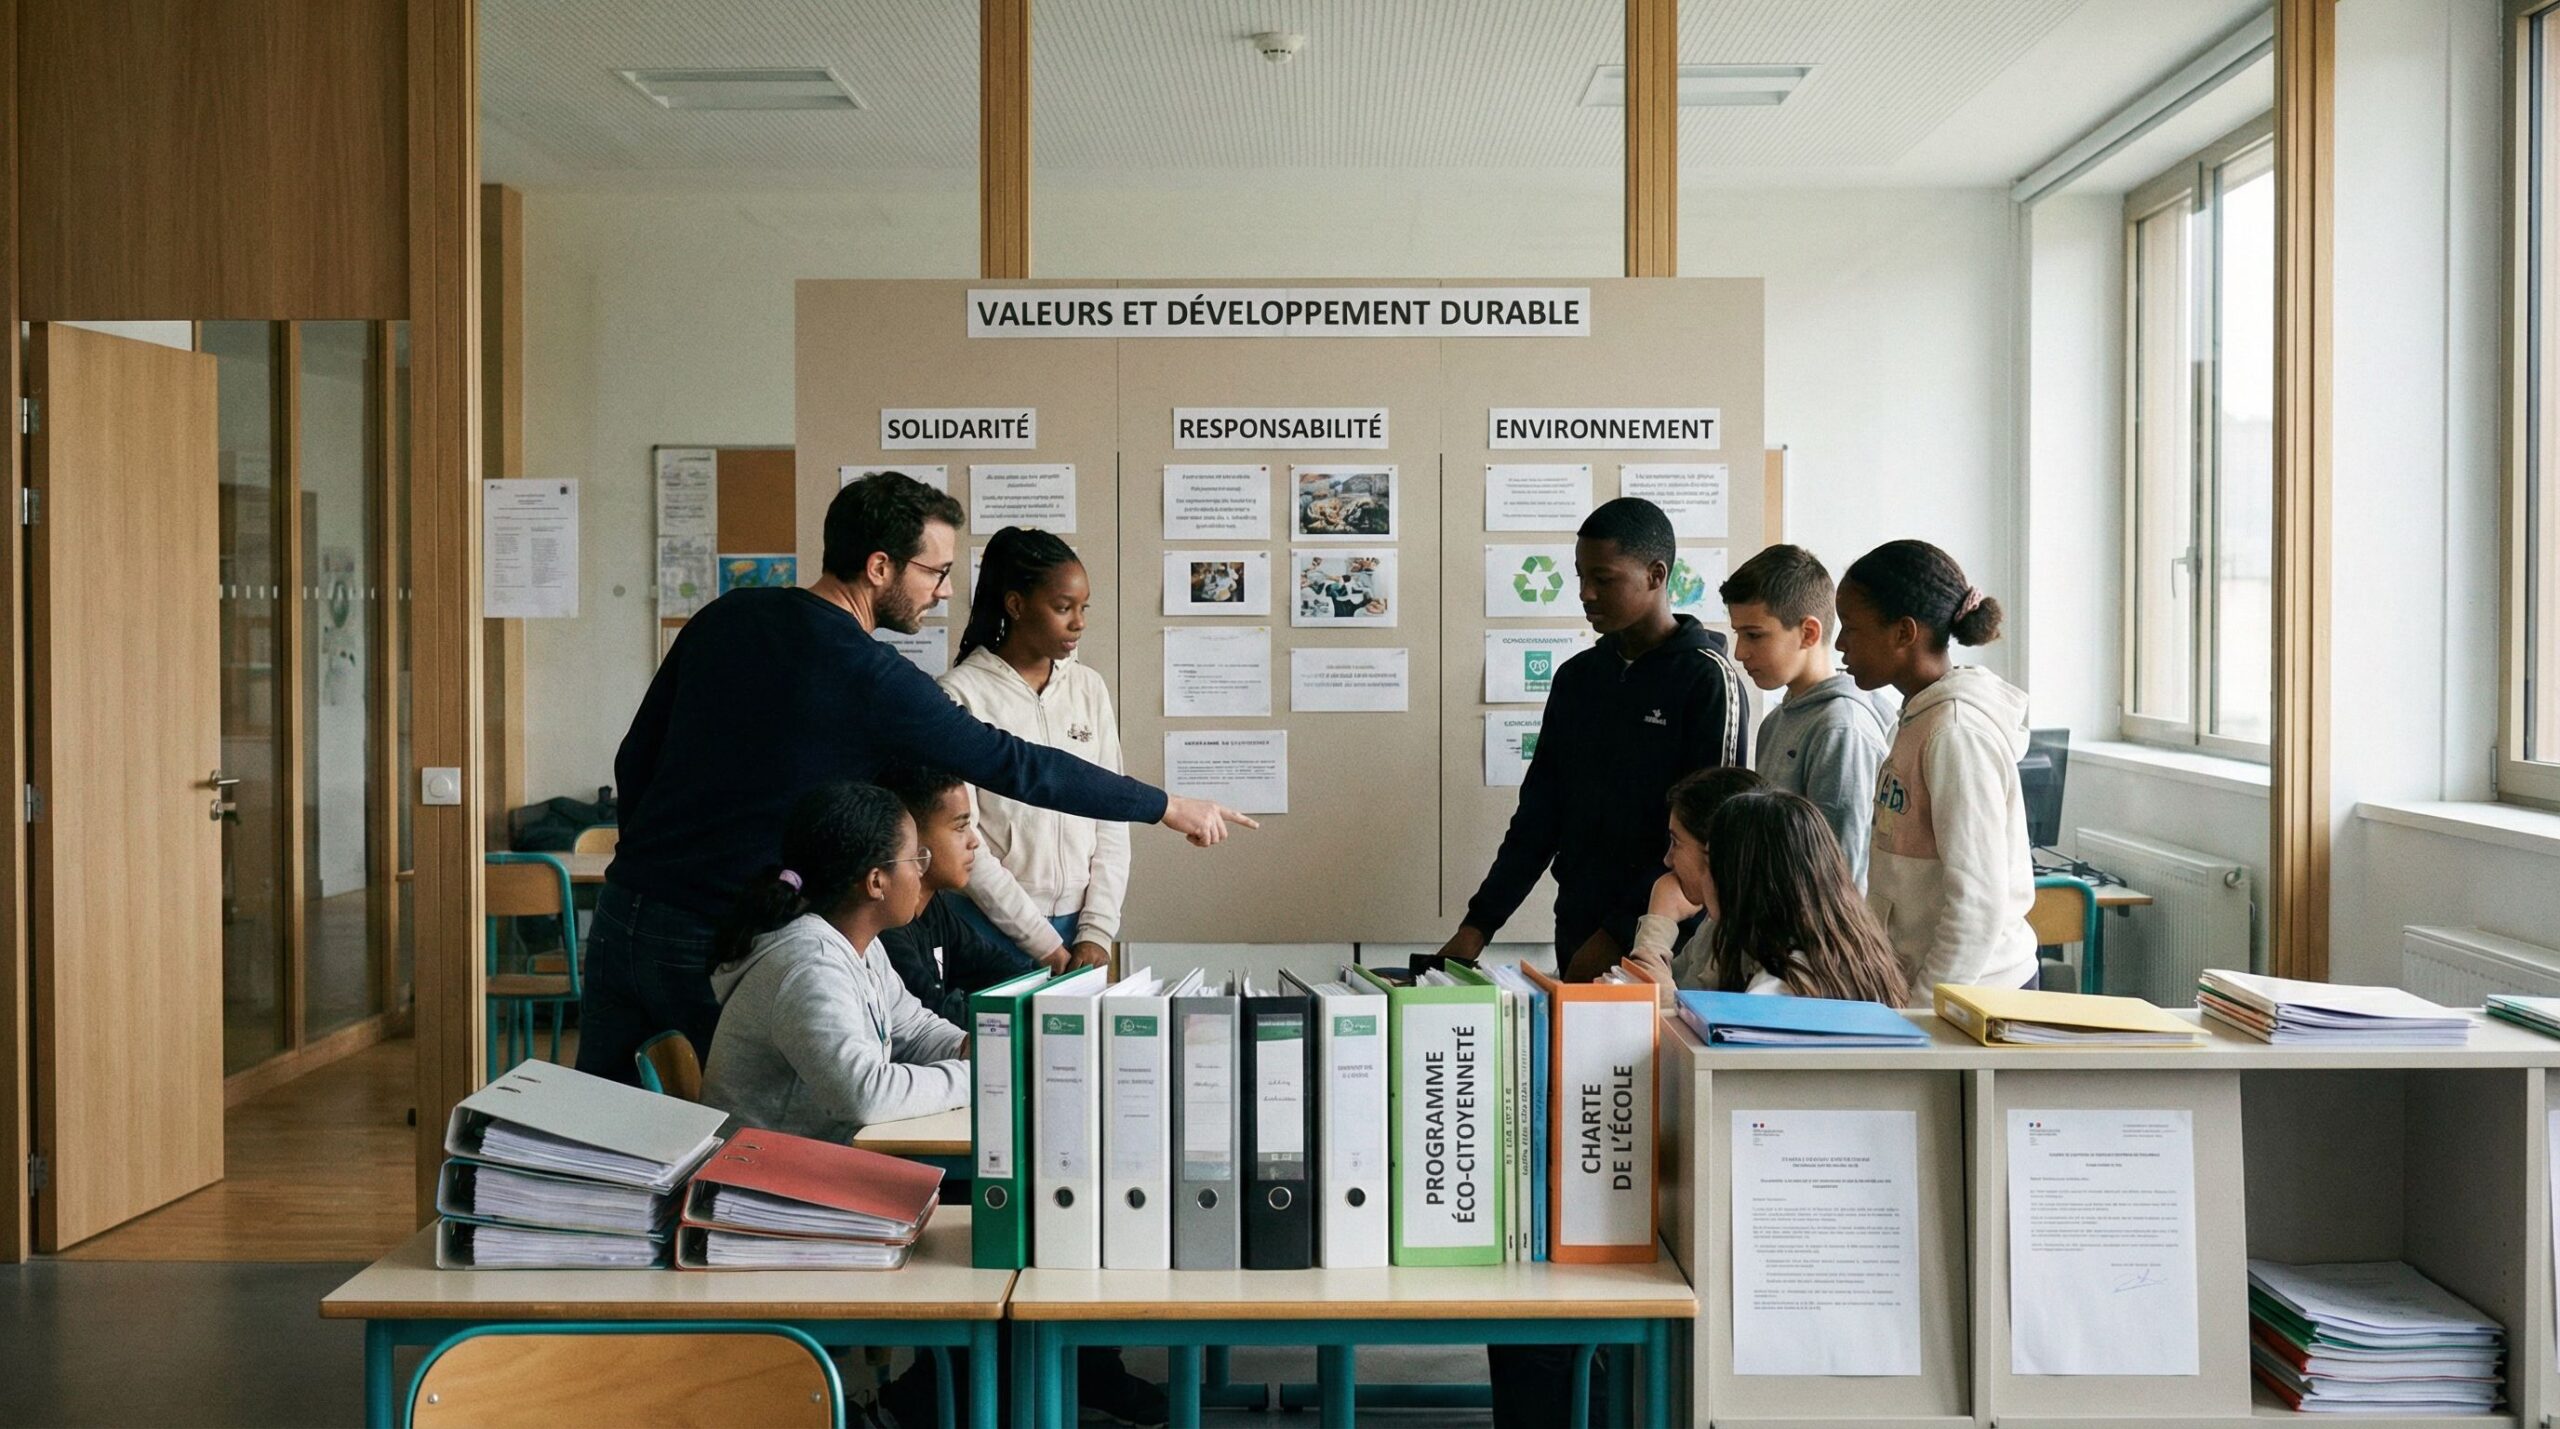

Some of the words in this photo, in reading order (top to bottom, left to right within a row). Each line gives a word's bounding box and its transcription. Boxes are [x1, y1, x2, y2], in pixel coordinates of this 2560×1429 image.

[977, 300, 1113, 327] VALEURS
[1123, 301, 1158, 326] ET
[1167, 293, 1431, 326] DÉVELOPPEMENT
[1441, 300, 1579, 325] DURABLE
[887, 413, 1029, 440] SOLIDARITÉ
[1180, 413, 1382, 440] RESPONSABILITÉ
[1496, 419, 1714, 440] ENVIRONNEMENT
[1451, 1025, 1475, 1223] ÉCO-CITOYENNETÉ
[1606, 1065, 1633, 1153] L’ÉCOLE
[1425, 1051, 1445, 1205] PROGRAMME
[1581, 1084, 1602, 1174] CHARTE
[1612, 1160, 1633, 1191] DE
